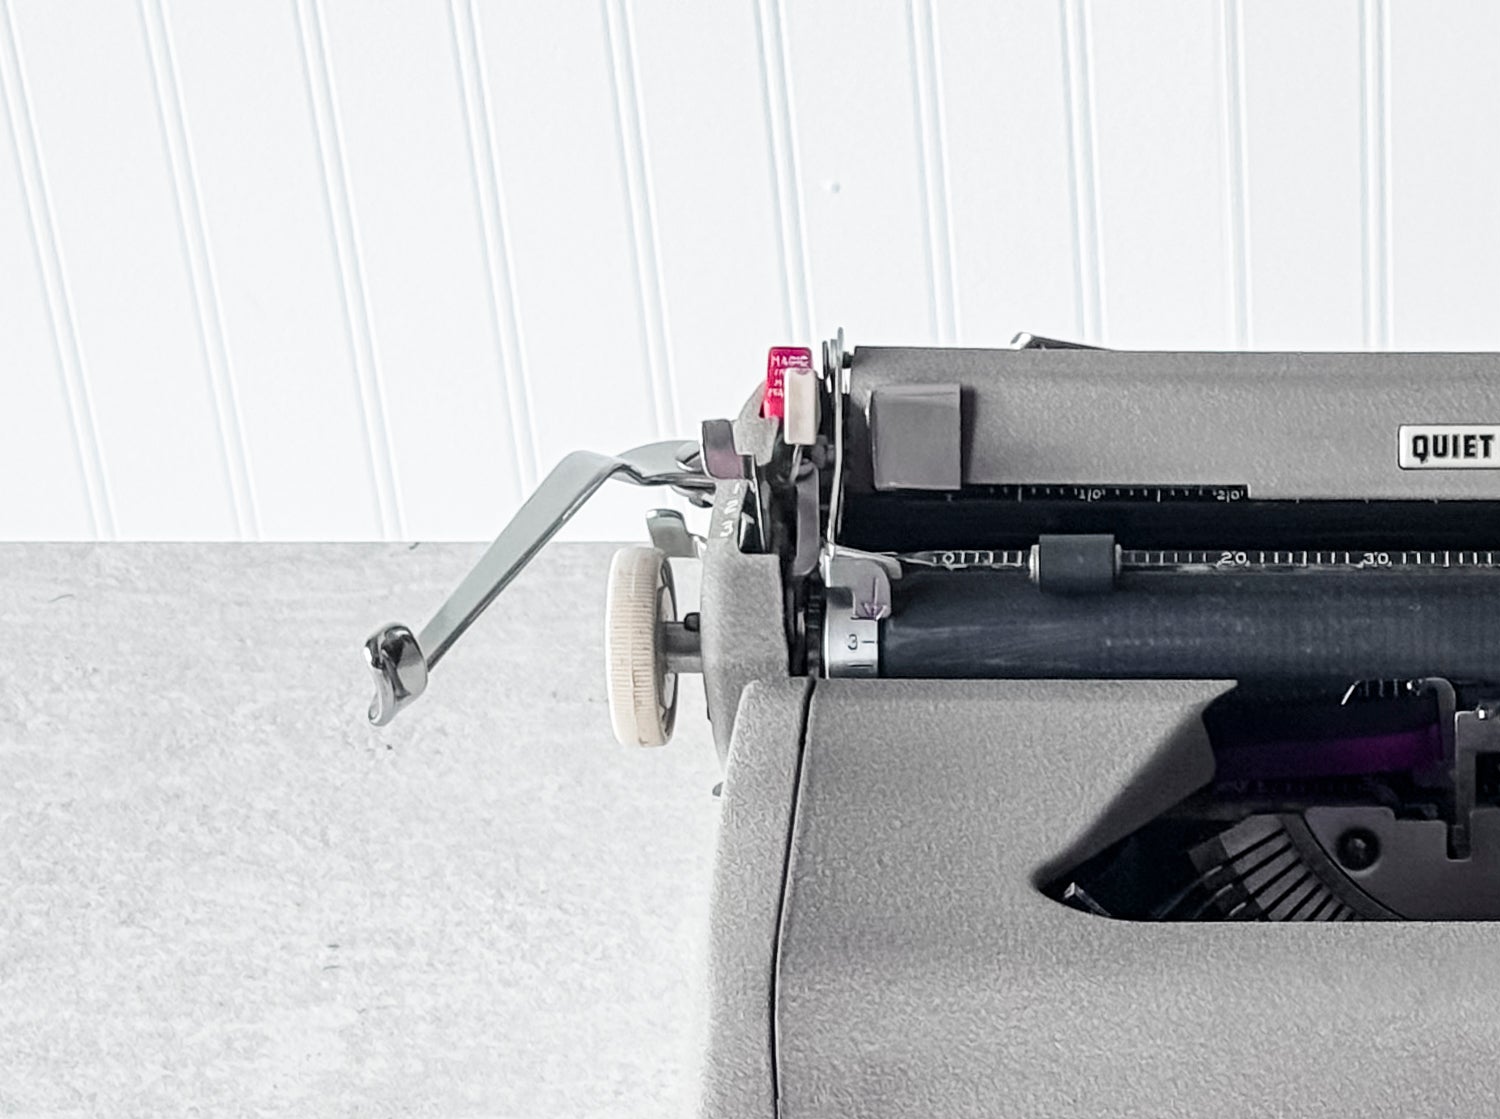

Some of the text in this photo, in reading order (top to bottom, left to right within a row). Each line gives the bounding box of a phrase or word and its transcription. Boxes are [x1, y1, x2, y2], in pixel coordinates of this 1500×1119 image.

[1412, 434, 1494, 464] QUIET
[724, 500, 739, 515] 2
[720, 520, 734, 537] 3
[1220, 551, 1247, 565] 20
[1363, 551, 1390, 565] 30
[847, 633, 858, 651] 3
